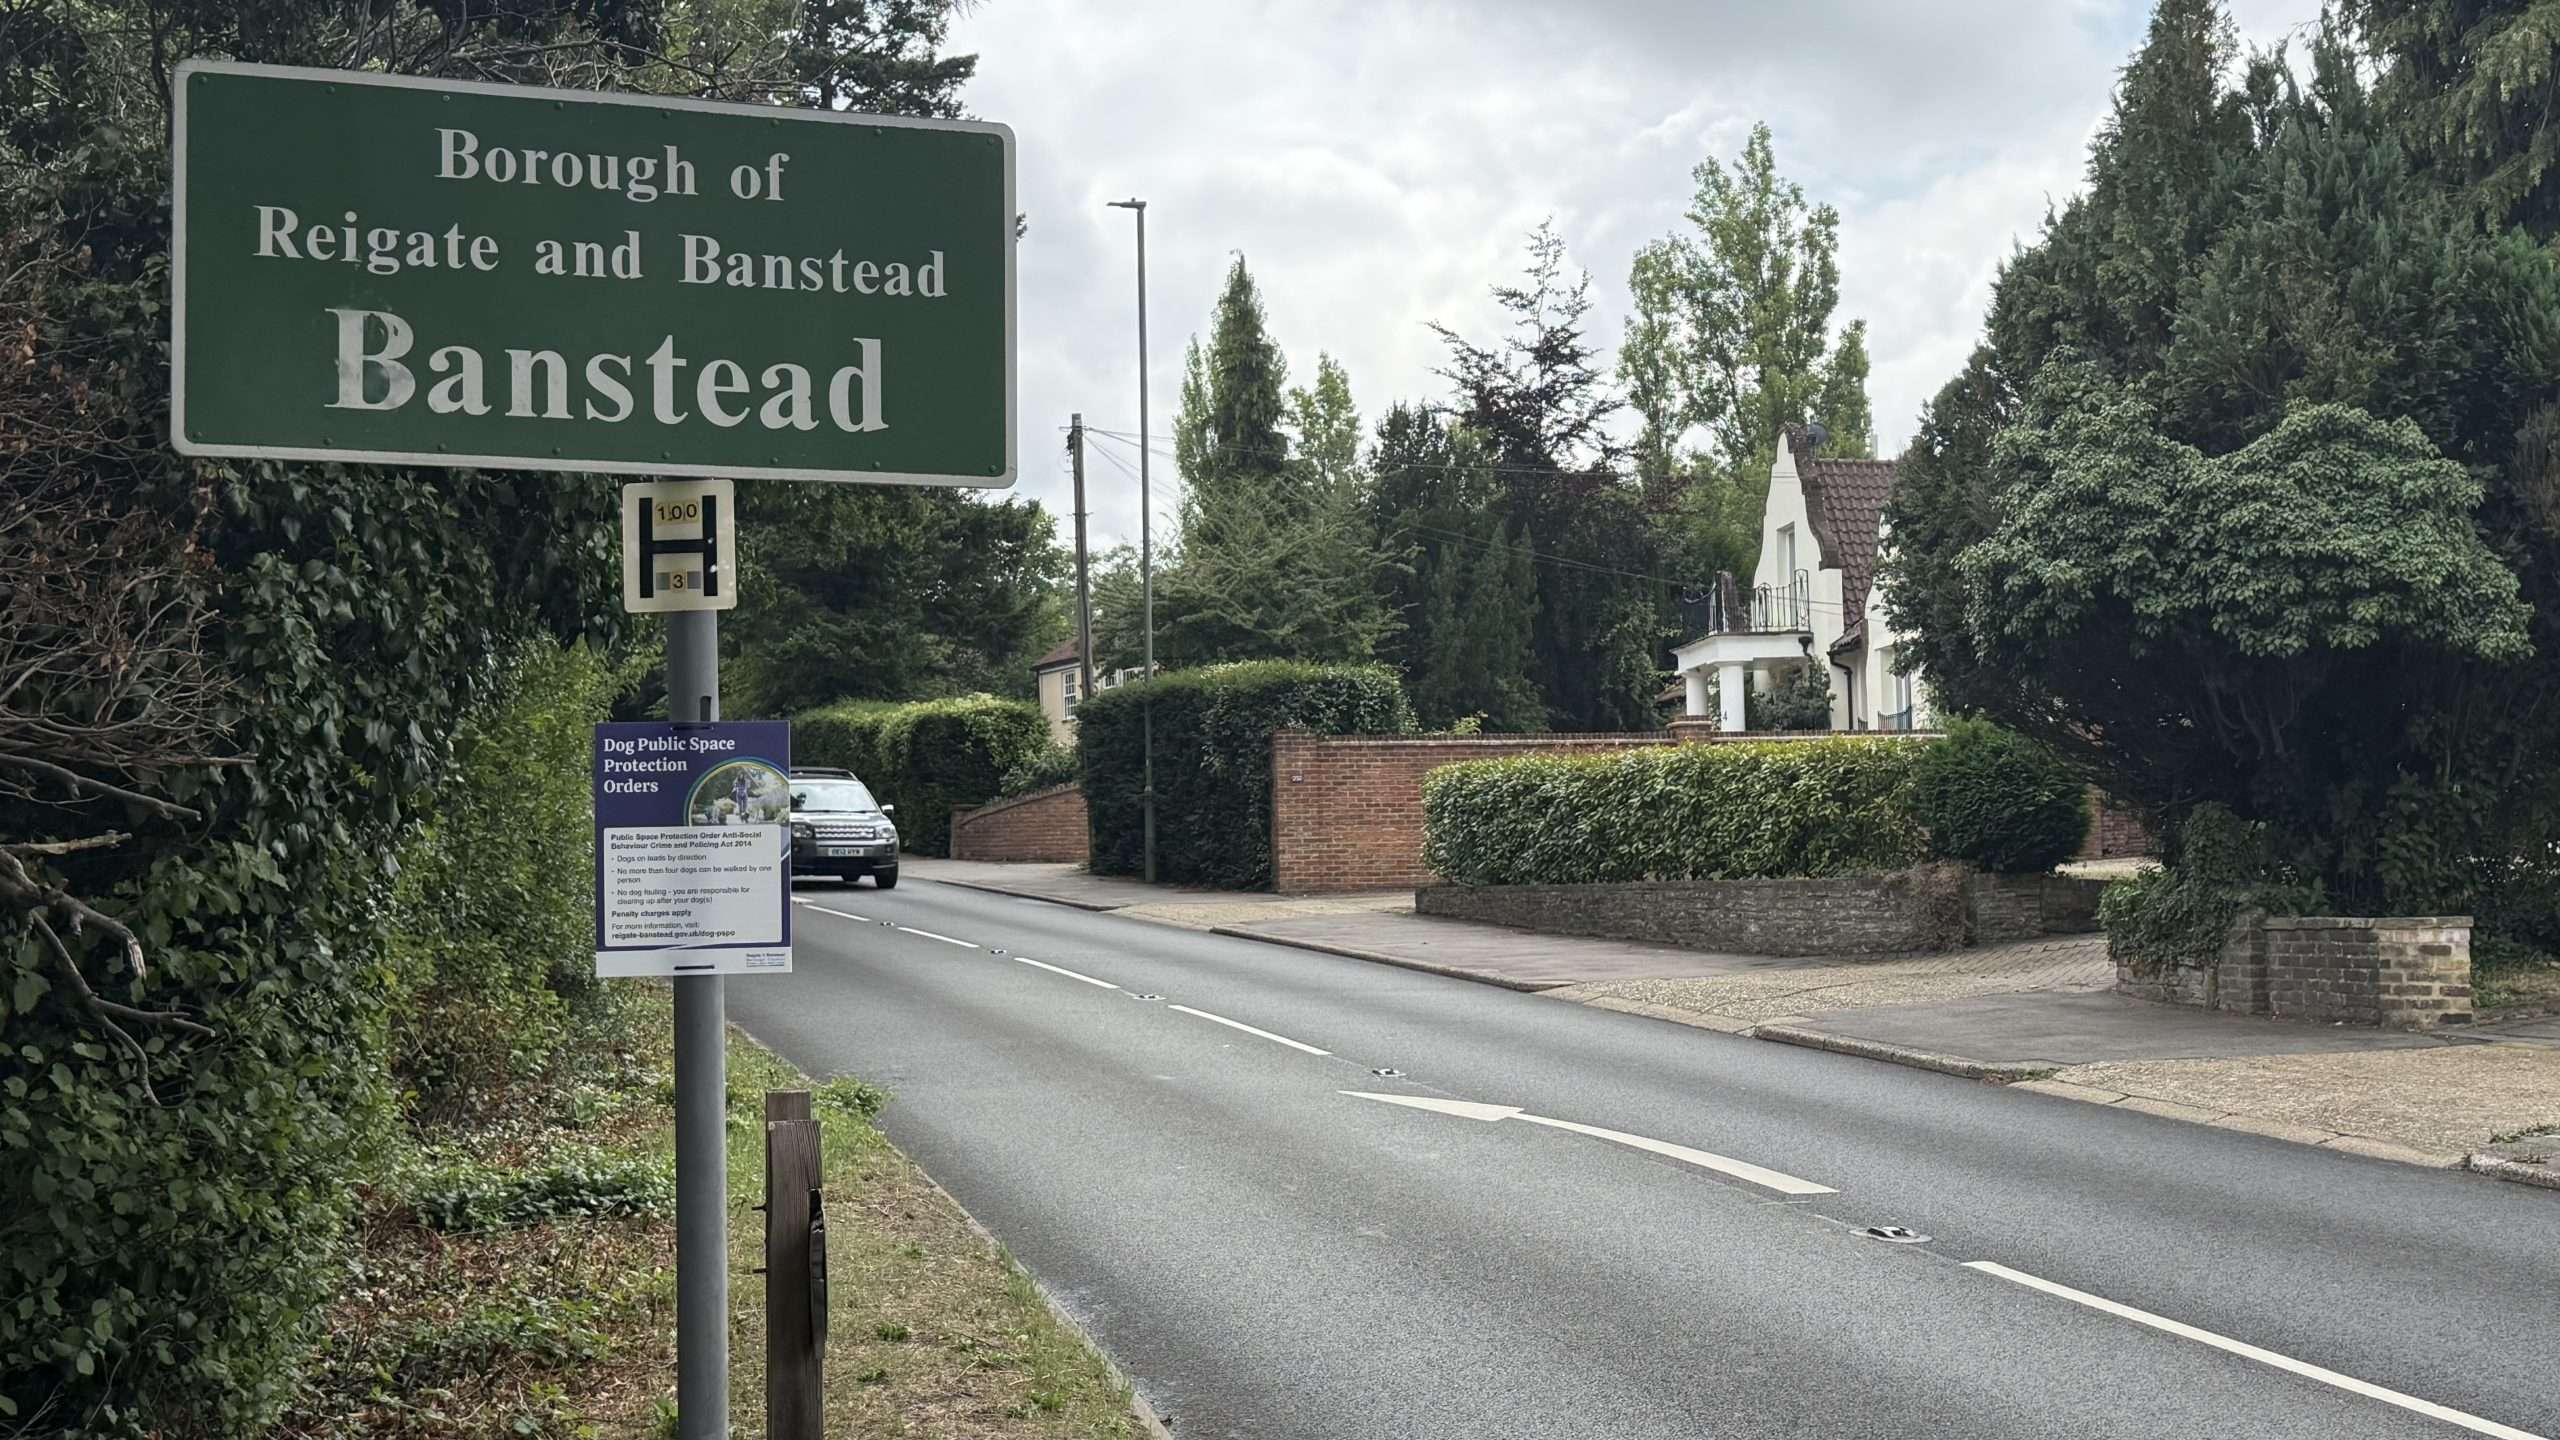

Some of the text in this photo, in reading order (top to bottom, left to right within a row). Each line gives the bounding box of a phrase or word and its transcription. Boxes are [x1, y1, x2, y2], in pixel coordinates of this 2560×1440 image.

[434, 128, 791, 203] Borough of
[253, 206, 948, 298] Reigate and Banstead
[324, 307, 889, 433] Banstead
[657, 503, 698, 520] 100
[639, 495, 718, 598] H
[672, 574, 684, 589] 3
[604, 736, 736, 756] Dog Public Space
[604, 757, 688, 773] Protection
[604, 779, 659, 793] Orders
[610, 831, 762, 841] Public Space Protection Order Anti-Social
[610, 842, 649, 850] Behaviour
[674, 841, 688, 849] and
[689, 841, 719, 849] Policing
[617, 855, 636, 863] Dogs
[680, 866, 698, 874] dogs
[749, 865, 758, 873] by
[617, 877, 641, 885] person
[628, 889, 642, 897] dog
[673, 897, 689, 905] your
[611, 909, 692, 918] Penalty charges apply
